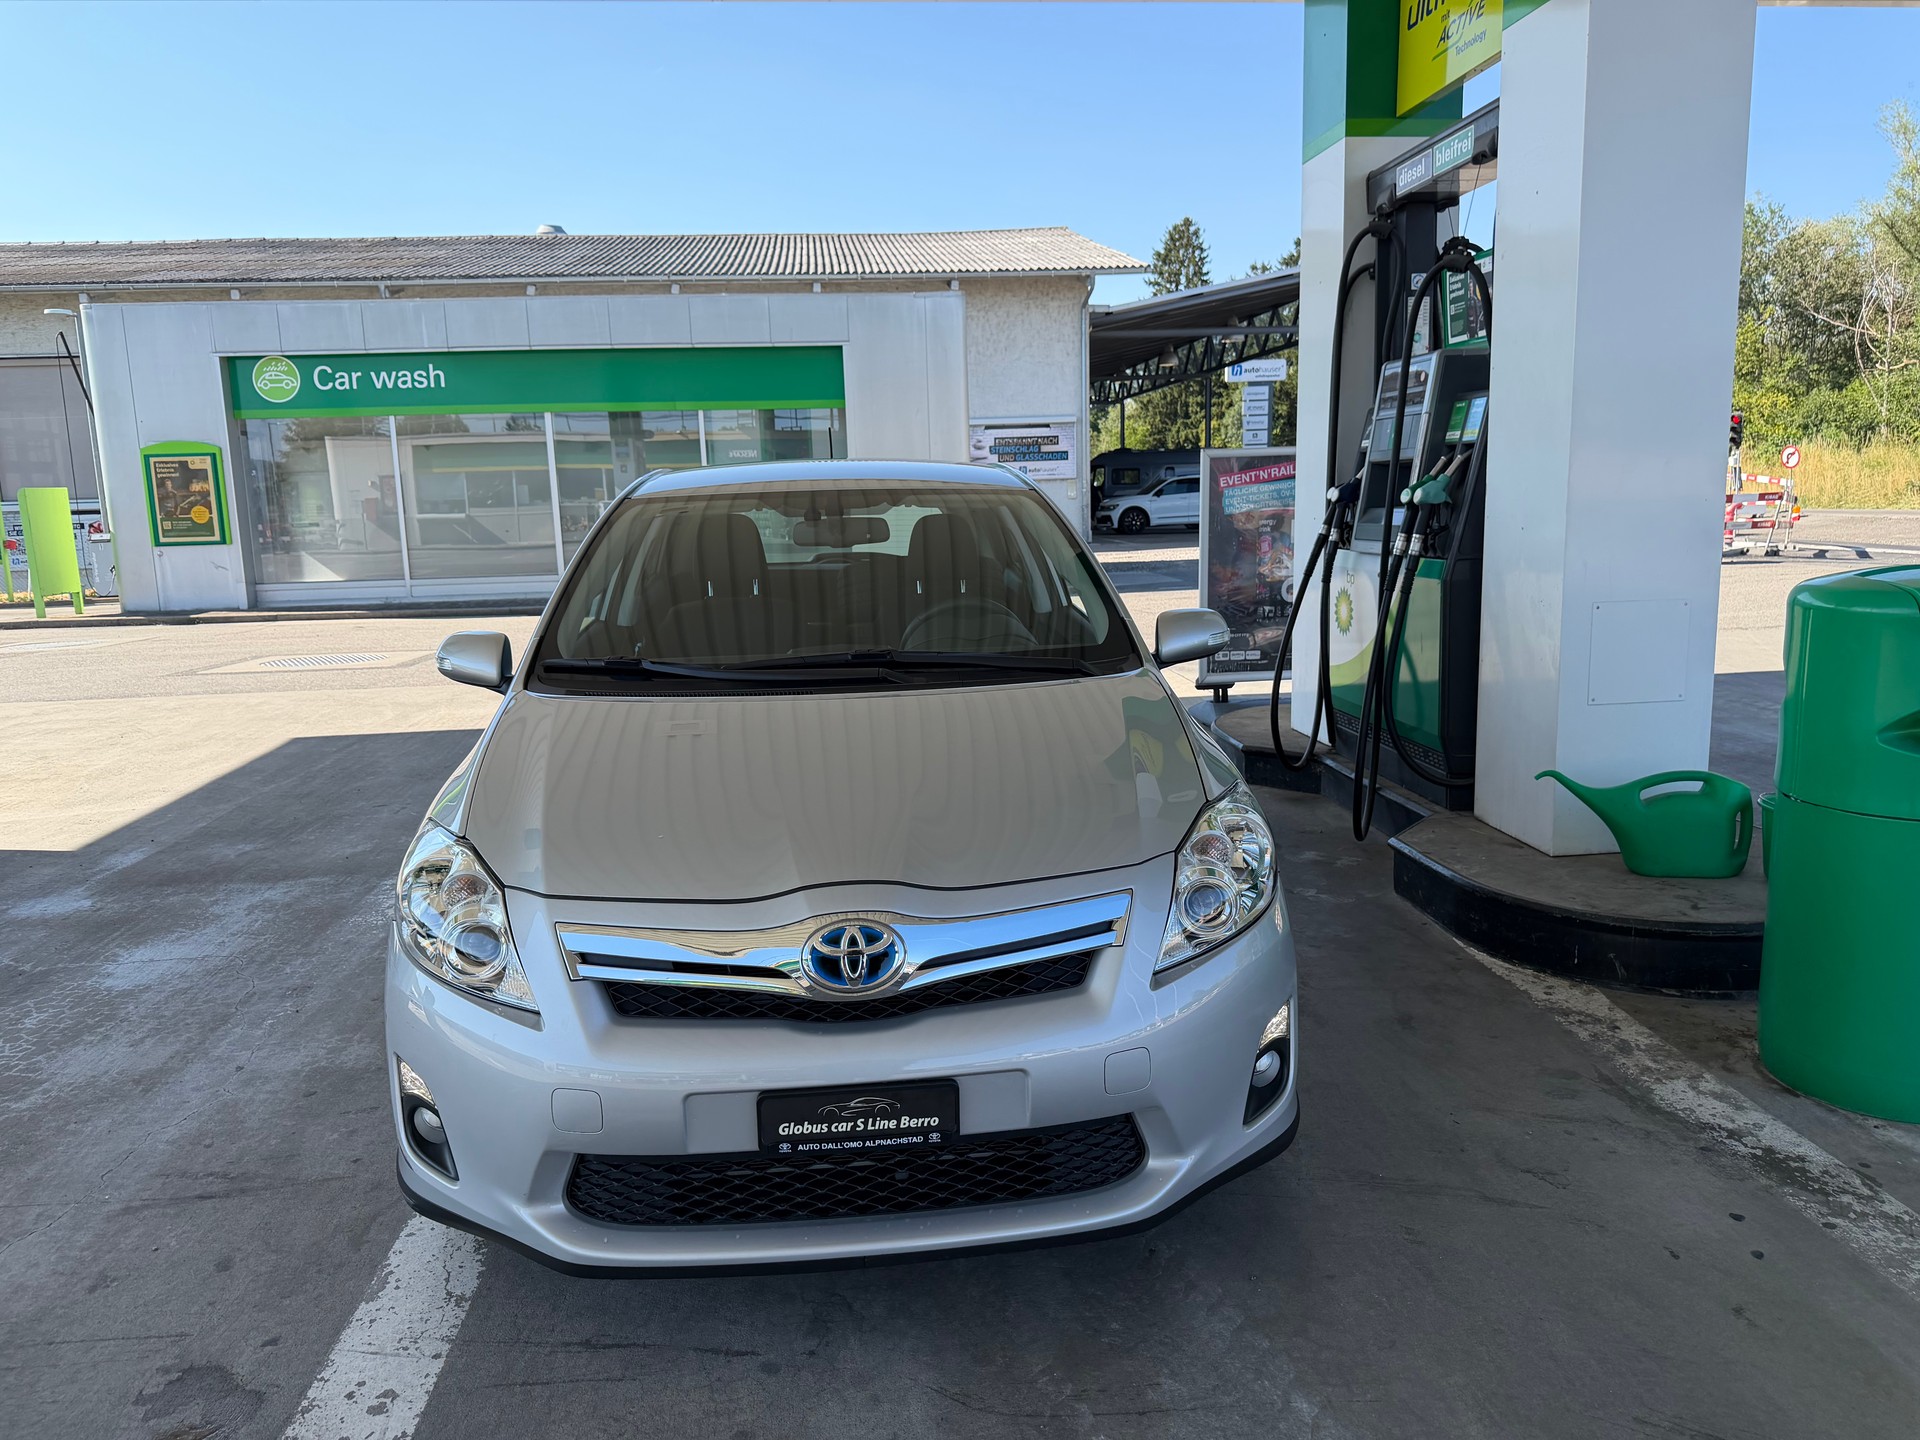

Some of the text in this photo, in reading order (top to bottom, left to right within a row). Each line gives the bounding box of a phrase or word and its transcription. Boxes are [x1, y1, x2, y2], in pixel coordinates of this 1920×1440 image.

[1436, 0, 1485, 48] ACTIVE
[1441, 9, 1450, 23] mit
[1455, 29, 1487, 56] Technology
[1435, 132, 1471, 167] bleifrei
[1399, 157, 1425, 187] diesel
[313, 363, 446, 391] Car wash
[991, 445, 1039, 454] STEINSCHLAG
[995, 437, 1058, 447] ENTSPANNT NACH
[999, 454, 1015, 462] UND
[1346, 570, 1355, 585] bp
[778, 1116, 940, 1136] Globus car S Line Berro
[797, 1135, 924, 1151] AUTO DALL'OMO ALPNACHSTAD
